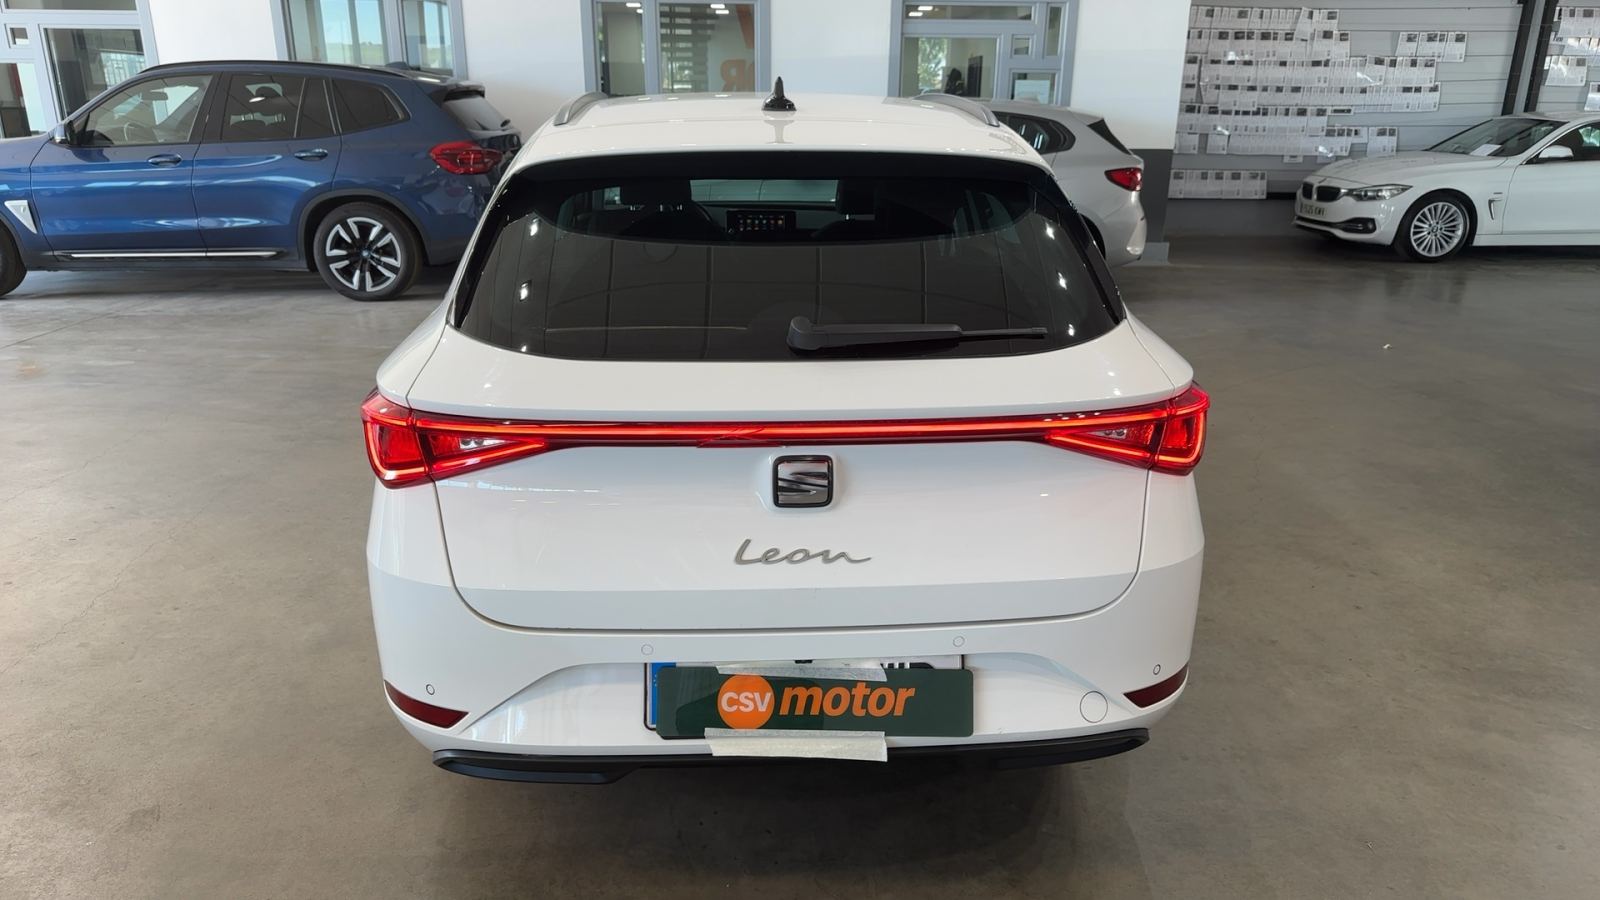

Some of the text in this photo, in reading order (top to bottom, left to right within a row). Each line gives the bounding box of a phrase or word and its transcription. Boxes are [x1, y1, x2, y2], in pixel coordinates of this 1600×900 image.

[734, 538, 872, 565] Leon
[720, 682, 916, 717] CSV motor
